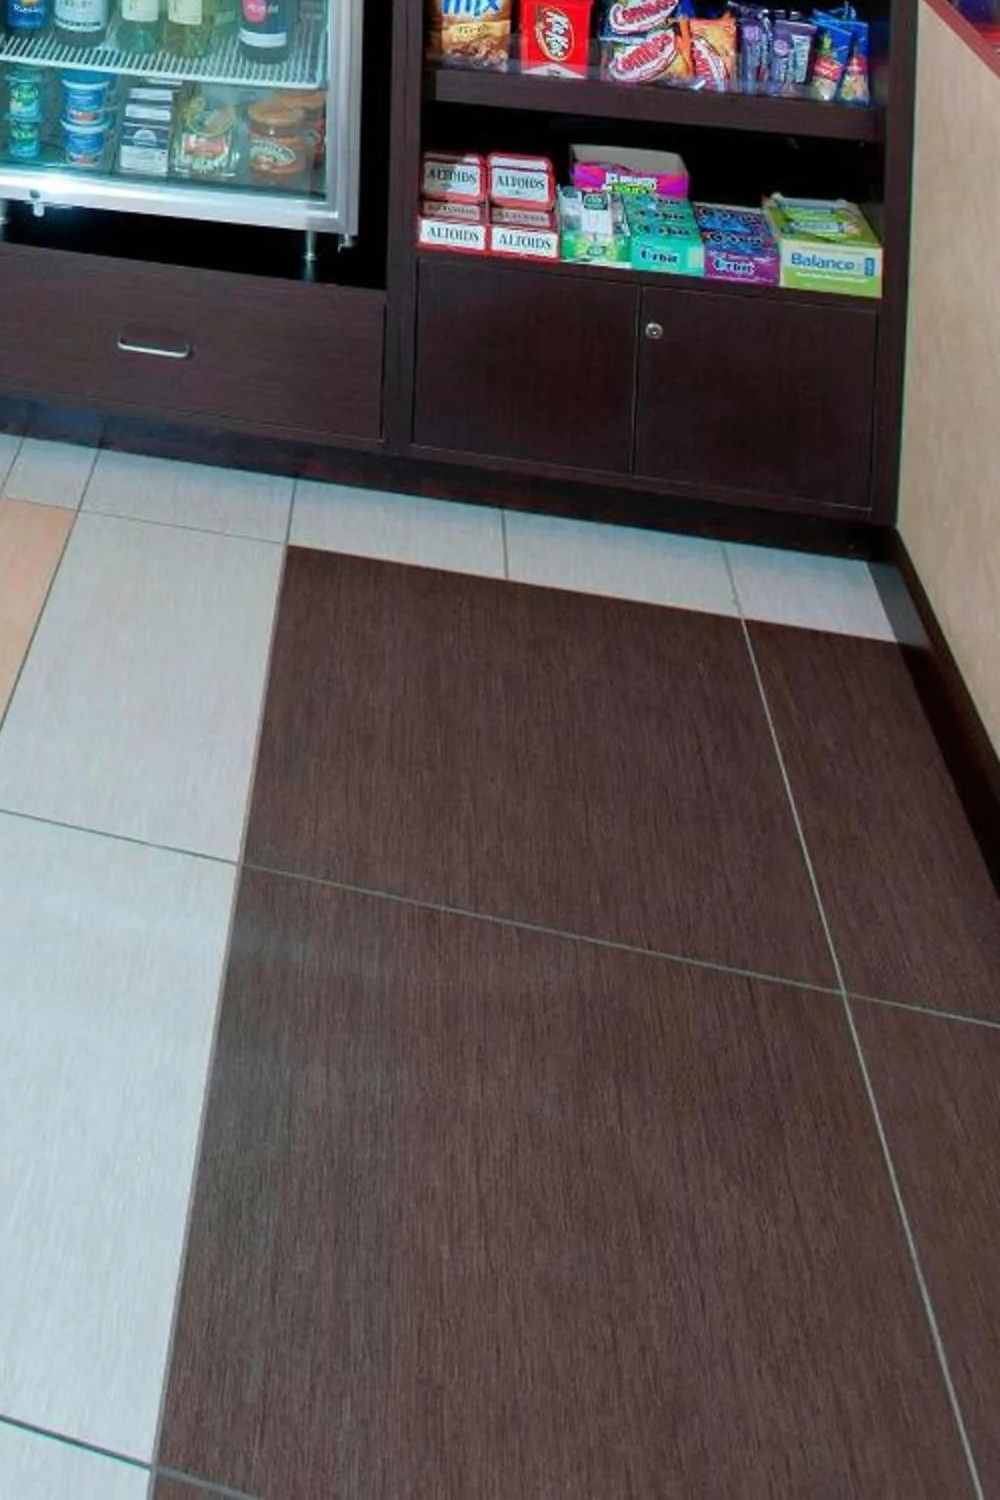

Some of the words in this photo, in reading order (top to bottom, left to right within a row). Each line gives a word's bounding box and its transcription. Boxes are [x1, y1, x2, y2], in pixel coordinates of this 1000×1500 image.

[497, 175, 546, 191] ALTOIDS
[429, 226, 480, 242] ALTOIDS
[499, 233, 552, 249] ALTOIDS
[790, 251, 855, 272] Balance
